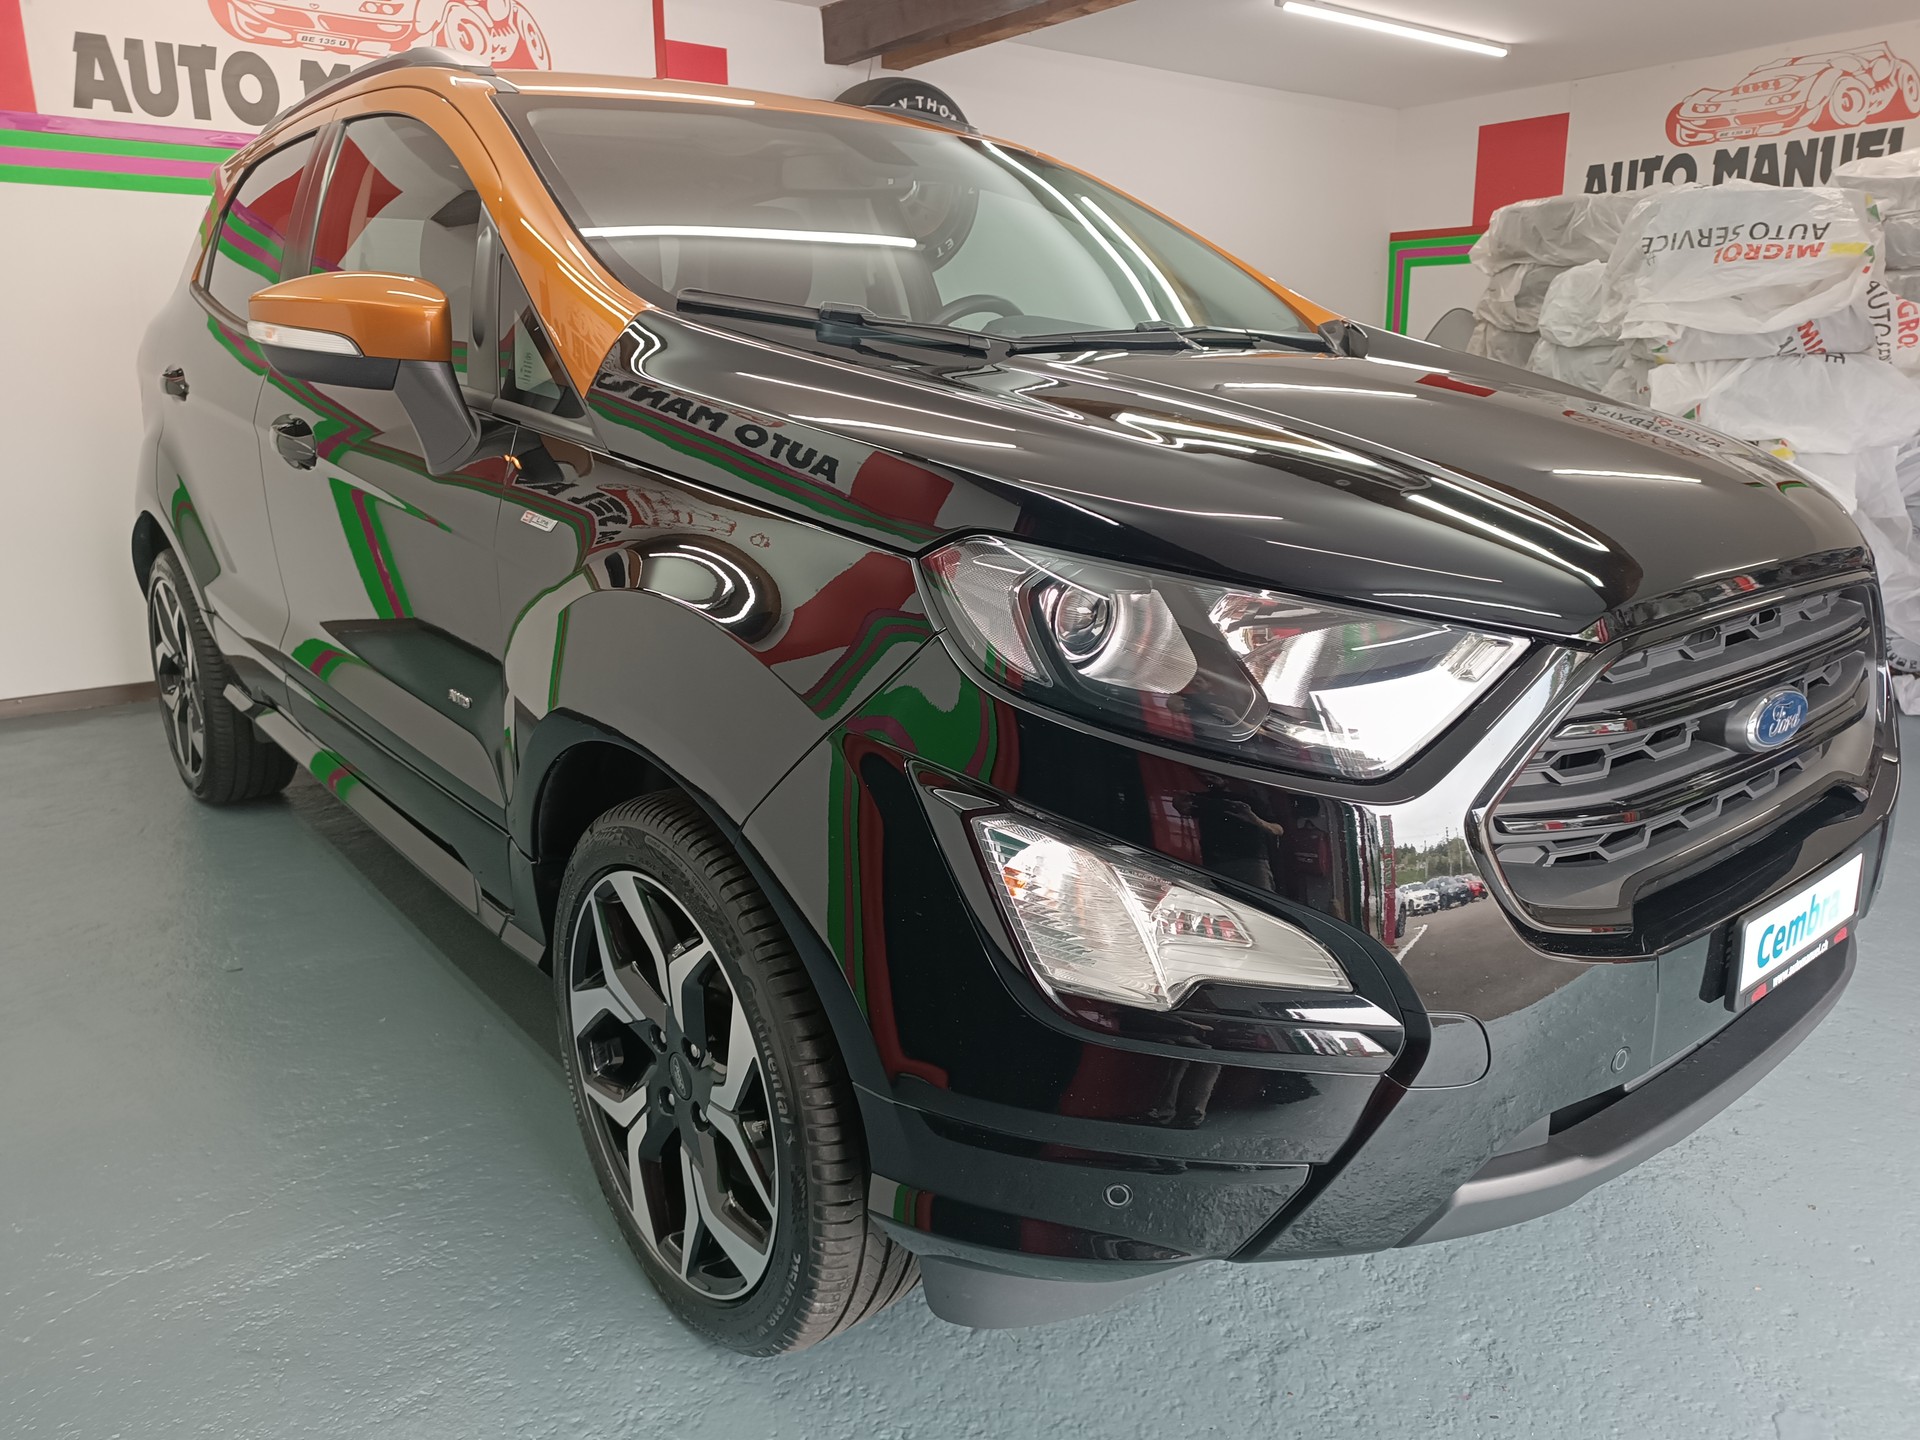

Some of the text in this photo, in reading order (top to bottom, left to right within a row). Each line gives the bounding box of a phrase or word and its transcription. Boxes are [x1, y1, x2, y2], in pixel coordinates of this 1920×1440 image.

[301, 35, 315, 43] BE
[319, 37, 336, 45] 135
[72, 31, 280, 126] AUTO
[1583, 153, 1698, 195] AUTO
[1641, 221, 1832, 255] AUTO SERVICE
[1768, 700, 1802, 738] Ford
[1757, 888, 1841, 969] Cembra
